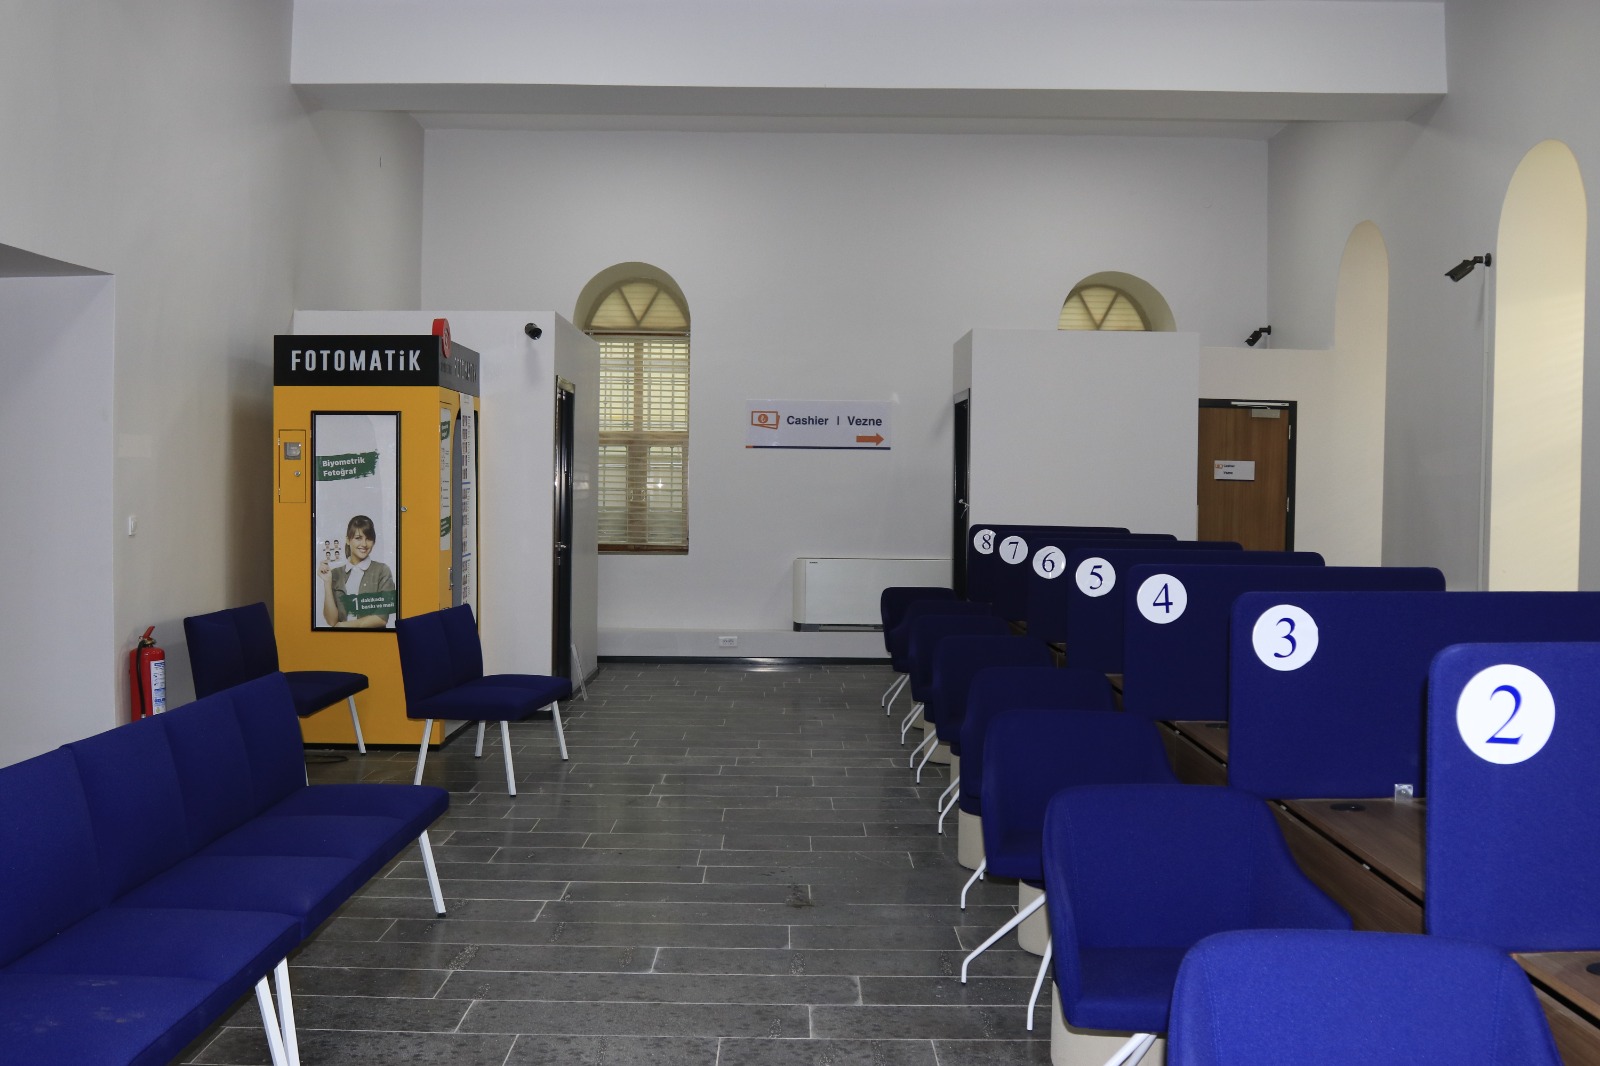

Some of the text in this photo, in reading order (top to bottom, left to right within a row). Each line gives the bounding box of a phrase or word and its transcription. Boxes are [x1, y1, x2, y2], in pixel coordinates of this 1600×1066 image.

[786, 416, 828, 426] Cashier
[847, 416, 883, 426] Vezne
[322, 457, 365, 467] Biyometrik
[323, 467, 357, 477] Fotoğraf
[982, 533, 992, 550] 8
[1008, 541, 1019, 560] 7
[1041, 551, 1056, 573] 6
[1089, 565, 1104, 590] 5
[352, 597, 359, 610] 1
[1152, 582, 1174, 614] 4
[1273, 617, 1297, 658] 3
[1485, 684, 1524, 745] 2
